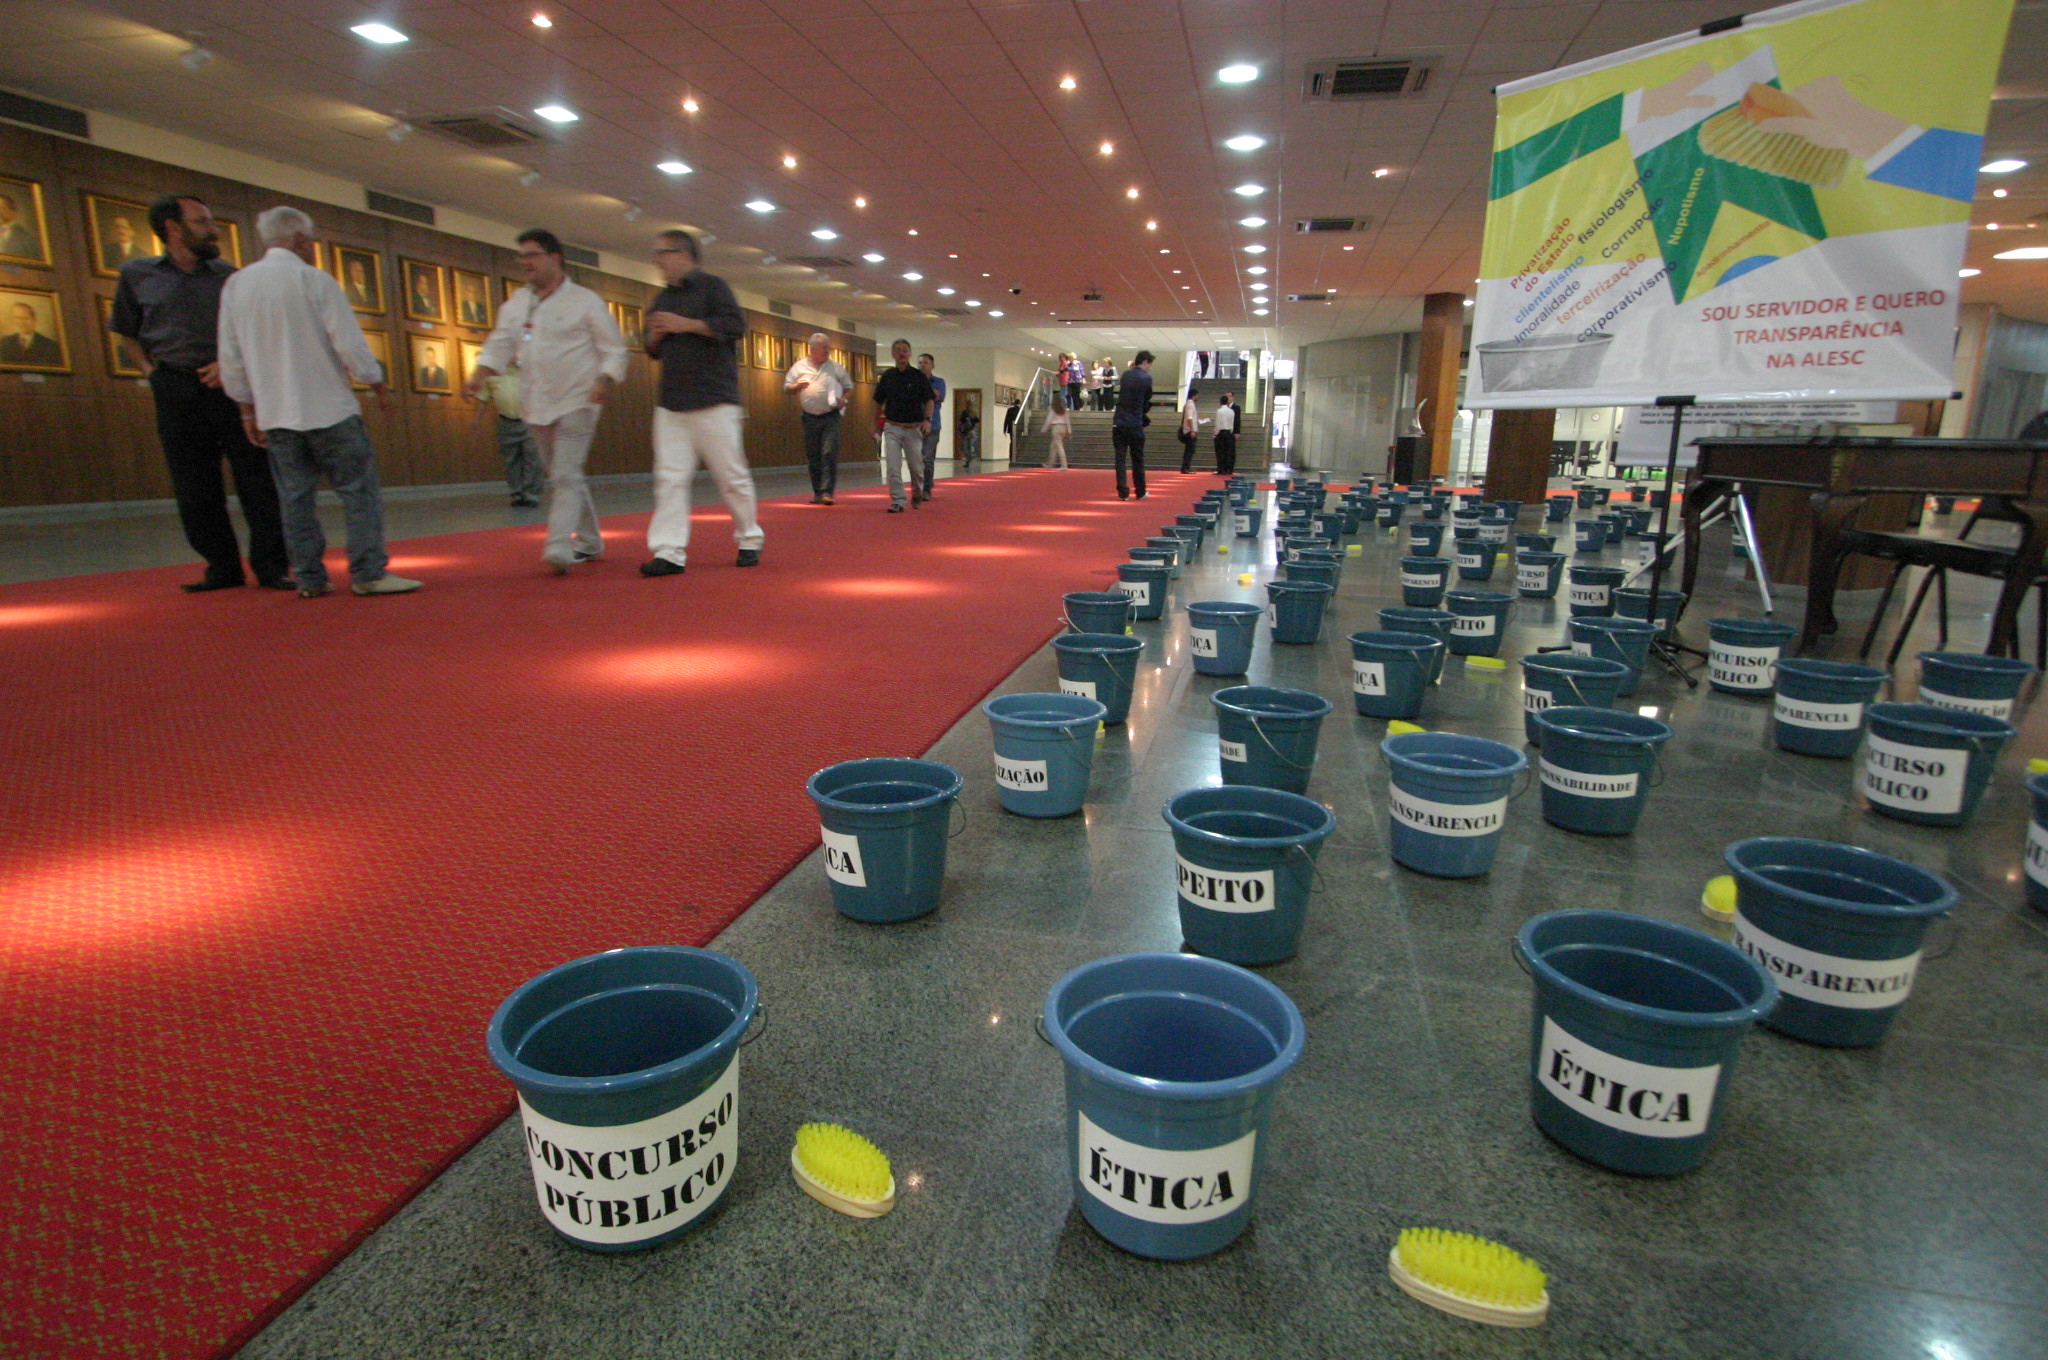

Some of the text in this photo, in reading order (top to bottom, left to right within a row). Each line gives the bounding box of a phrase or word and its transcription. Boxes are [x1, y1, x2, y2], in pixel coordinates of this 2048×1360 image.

[1577, 168, 1655, 245] fisiologismo
[1601, 197, 1664, 259] Corrupção
[1667, 168, 1705, 245] Nepotismo
[1510, 217, 1571, 289] Privatização
[1525, 233, 1575, 292] do Estado
[1556, 253, 1647, 325] terceirização
[1515, 256, 1585, 324] clientelismo
[1577, 260, 1678, 343] corporativismo
[1701, 289, 1947, 322] SOU SERVIDOR E QUERO
[1734, 321, 1904, 345] TRANSPARÊNCIA
[1766, 350, 1866, 369] NA ALESC
[1549, 1048, 1693, 1124] ÉTICA
[526, 1091, 734, 1181] CONCURSO
[544, 1151, 725, 1228] PÚBLICO
[1089, 1145, 1235, 1211] ÉTICA
